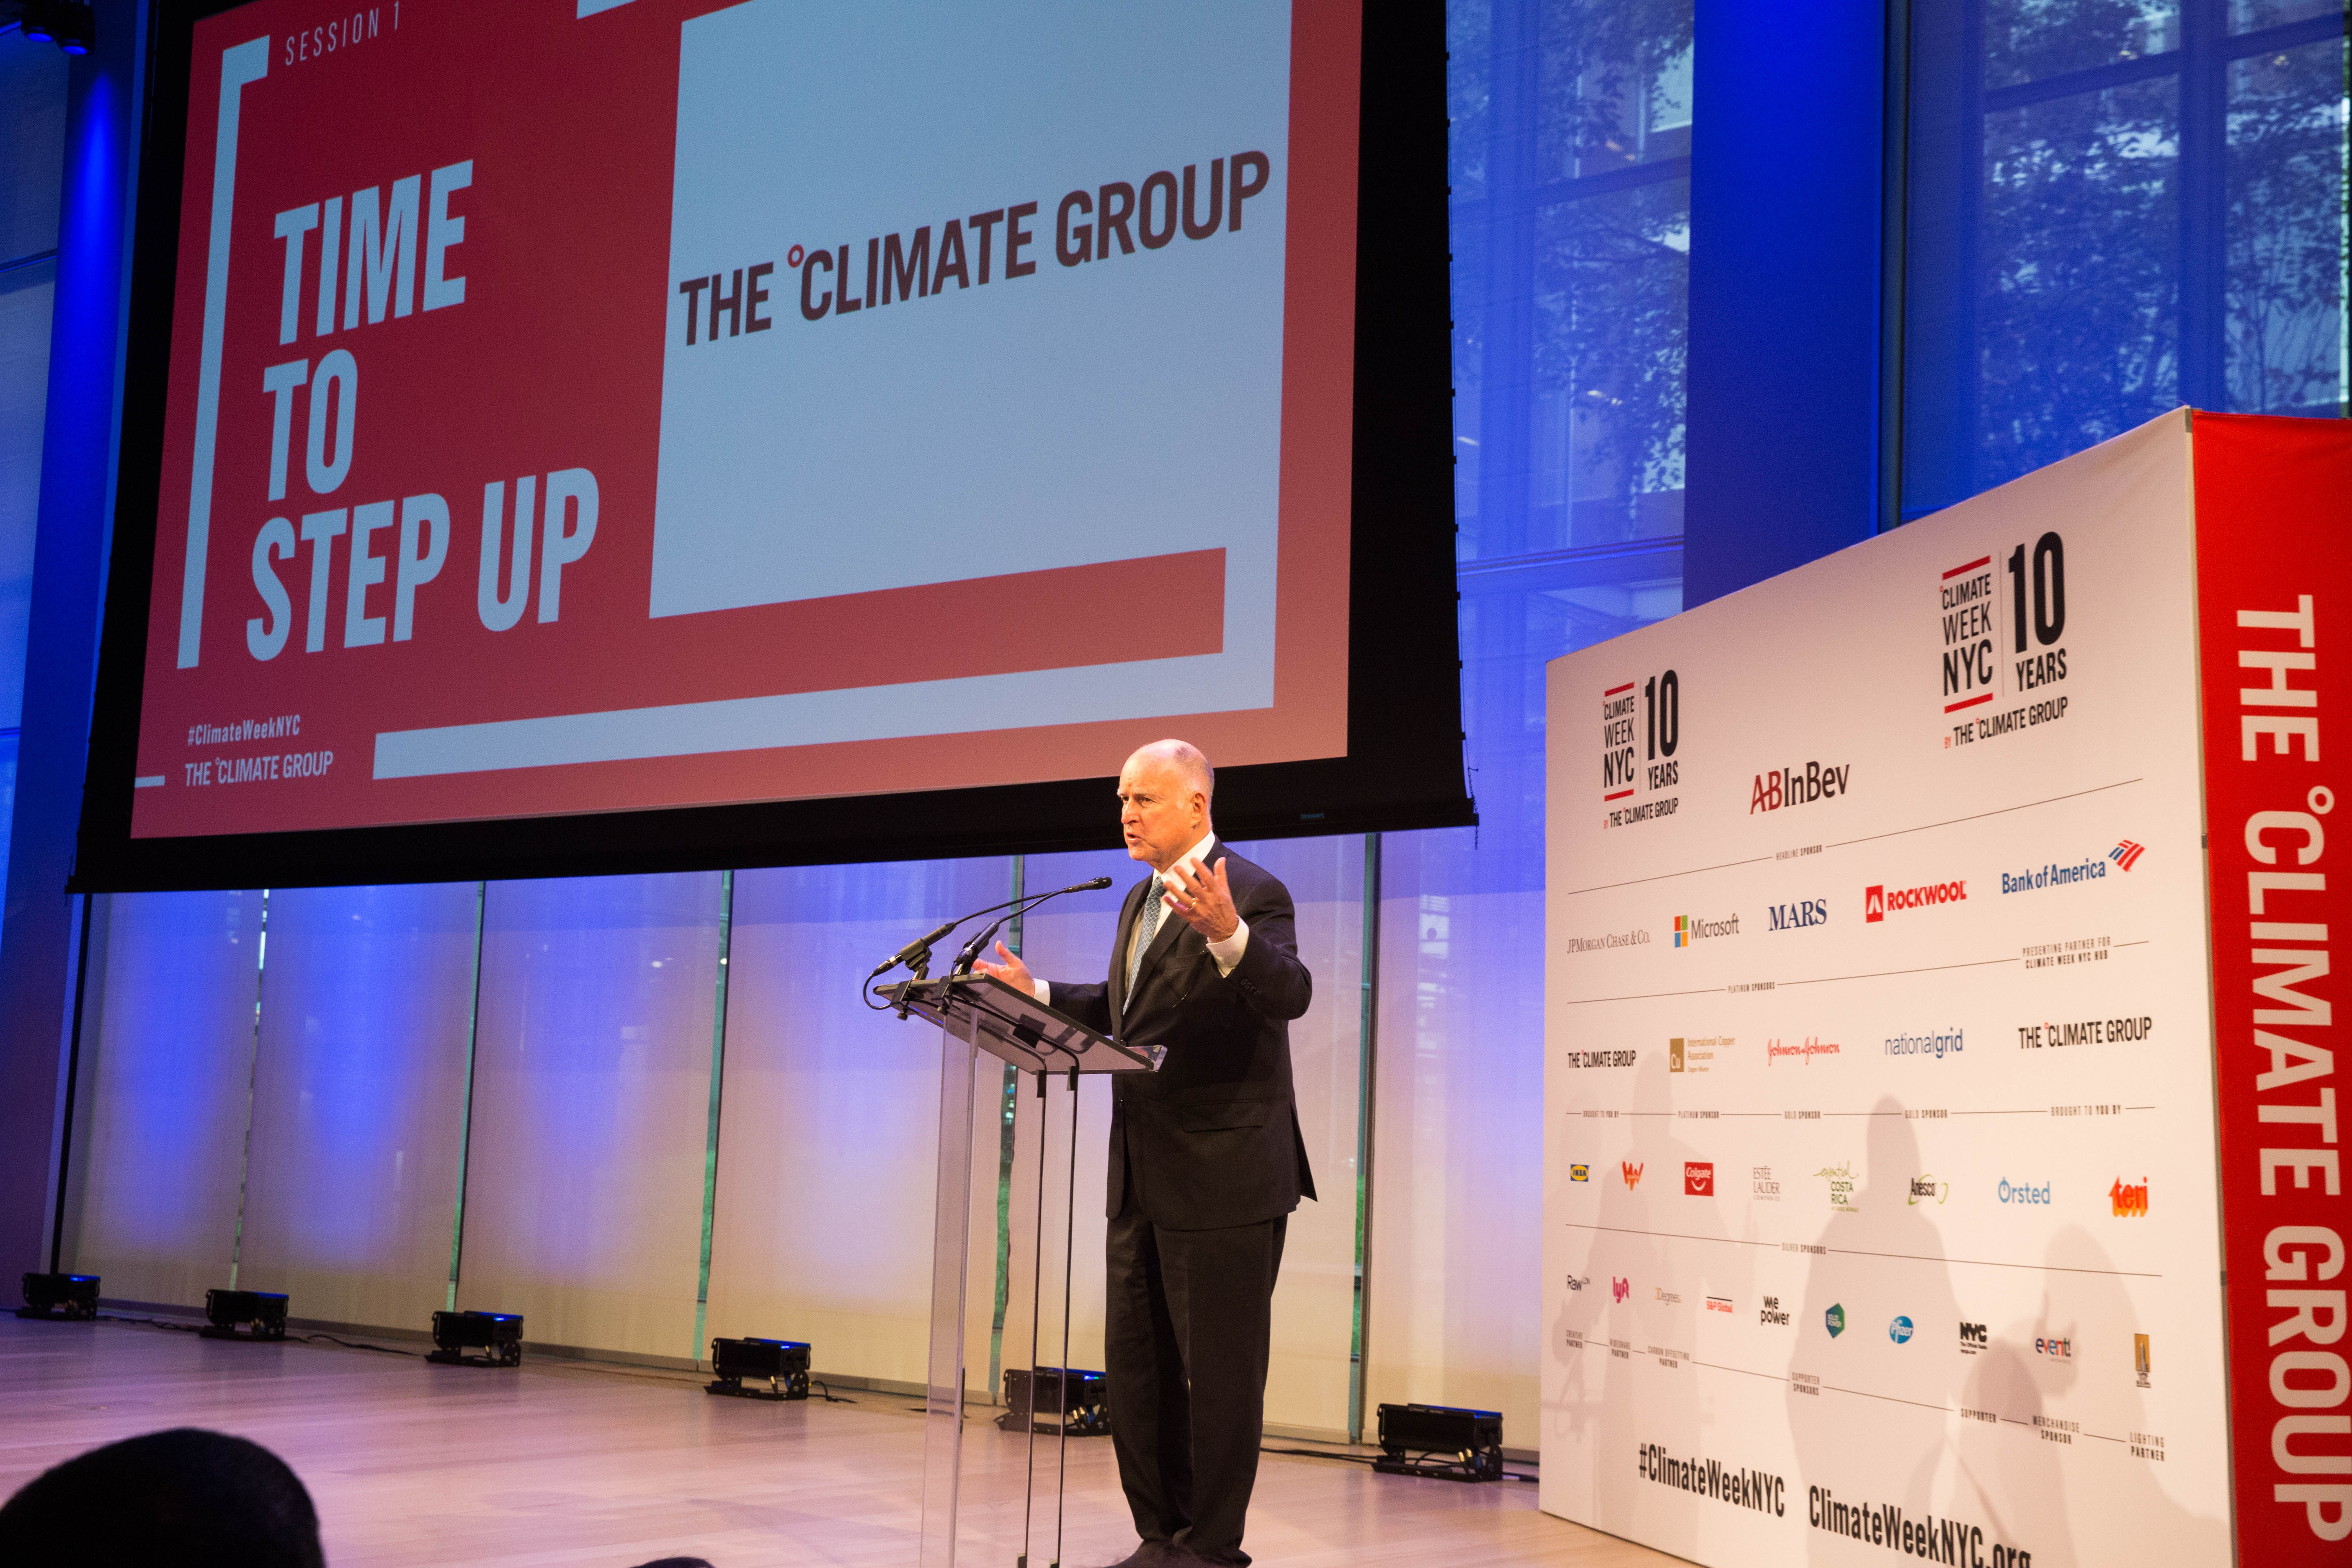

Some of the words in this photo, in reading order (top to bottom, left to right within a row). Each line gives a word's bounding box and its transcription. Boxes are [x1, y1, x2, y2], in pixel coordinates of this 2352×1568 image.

[285, 7, 379, 66] SESSION
[394, 1, 400, 30] 1
[274, 159, 474, 345] TIME
[679, 261, 774, 346] THE
[1054, 150, 1271, 267] GROUP
[263, 349, 358, 501] TO
[246, 493, 450, 661] STEP
[477, 467, 599, 632] UP
[2008, 531, 2065, 654] 10
[1942, 601, 1992, 646] WEEK
[1943, 639, 1993, 696] NYC
[2016, 648, 2067, 692] YEARS
[2237, 594, 2320, 762] THE
[1645, 670, 1678, 761] 10
[1953, 722, 1973, 746] THE
[2029, 696, 2068, 726] GROUP
[187, 714, 301, 746] #ClimateWeekNYC
[1604, 717, 1634, 749] WEEK
[185, 761, 212, 786] THE
[282, 751, 334, 778] GROUP
[1604, 746, 1634, 788] NYC
[1648, 760, 1679, 791] YEARS
[1609, 811, 1622, 828] THE
[1655, 797, 1679, 817] GROUP
[1776, 849, 1799, 860] HEADLINE
[1800, 844, 1822, 856] SPONSOR
[2002, 869, 2034, 894] Bank
[2036, 865, 2048, 888] of
[2050, 858, 2106, 886] America
[1887, 880, 1967, 911] ROCKWOOL
[1691, 913, 1740, 940] Microsoft
[1768, 898, 1827, 931] MARS
[1630, 931, 1637, 945] &
[2022, 942, 2062, 957] PRESENTING
[2065, 938, 2095, 951] PARTNER
[2098, 936, 2111, 947] FOR
[2026, 957, 2054, 969] CLIMATE
[2058, 953, 2075, 965] WEEK
[2078, 951, 2091, 962] NYC
[2095, 949, 2108, 960] HUB
[1728, 983, 1750, 993] PLATINUM
[1751, 981, 1775, 992] SPONSORS
[2018, 1026, 2042, 1049] THE
[2107, 1016, 2152, 1043] GROUP
[1568, 1052, 1580, 1069] THE
[1613, 1050, 1636, 1067] GROUP
[1677, 1111, 1698, 1119] PLATINUM
[1700, 1111, 1719, 1119] SPONSOR
[1784, 1111, 1796, 1119] GOLD
[1798, 1111, 1821, 1119] SPONSOR
[1904, 1110, 1919, 1119] GOLD
[1921, 1109, 1948, 1119] SPONSOR
[2050, 1106, 2081, 1116] BROUGHT
[2085, 1105, 2092, 1116] TO
[2096, 1105, 2109, 1115] YOU
[1572, 1169, 1587, 1177] IKEA
[1686, 1167, 1711, 1181] Colgate
[1753, 1181, 1780, 1194] LAUDER
[1831, 1181, 1854, 1193] COSTA
[1831, 1193, 1849, 1205] RICA
[1800, 1244, 1826, 1255] SPONSORS
[1761, 1310, 1789, 1326] power
[1960, 1322, 1987, 1343] NYC
[1792, 1372, 1820, 1385] SUPPORTER
[1793, 1383, 1819, 1396] SPONSORS
[2263, 1225, 2352, 1541] GROUP
[1960, 1408, 1997, 1423] SUPPORTER
[2033, 1415, 2080, 1433] MERCHANDISE
[2041, 1430, 2072, 1445] SPONSOR
[2130, 1432, 2165, 1448] LIGHTING
[2130, 1446, 2165, 1462] PARTNER
[1639, 1443, 1785, 1518] #ClimateWeekNYC
